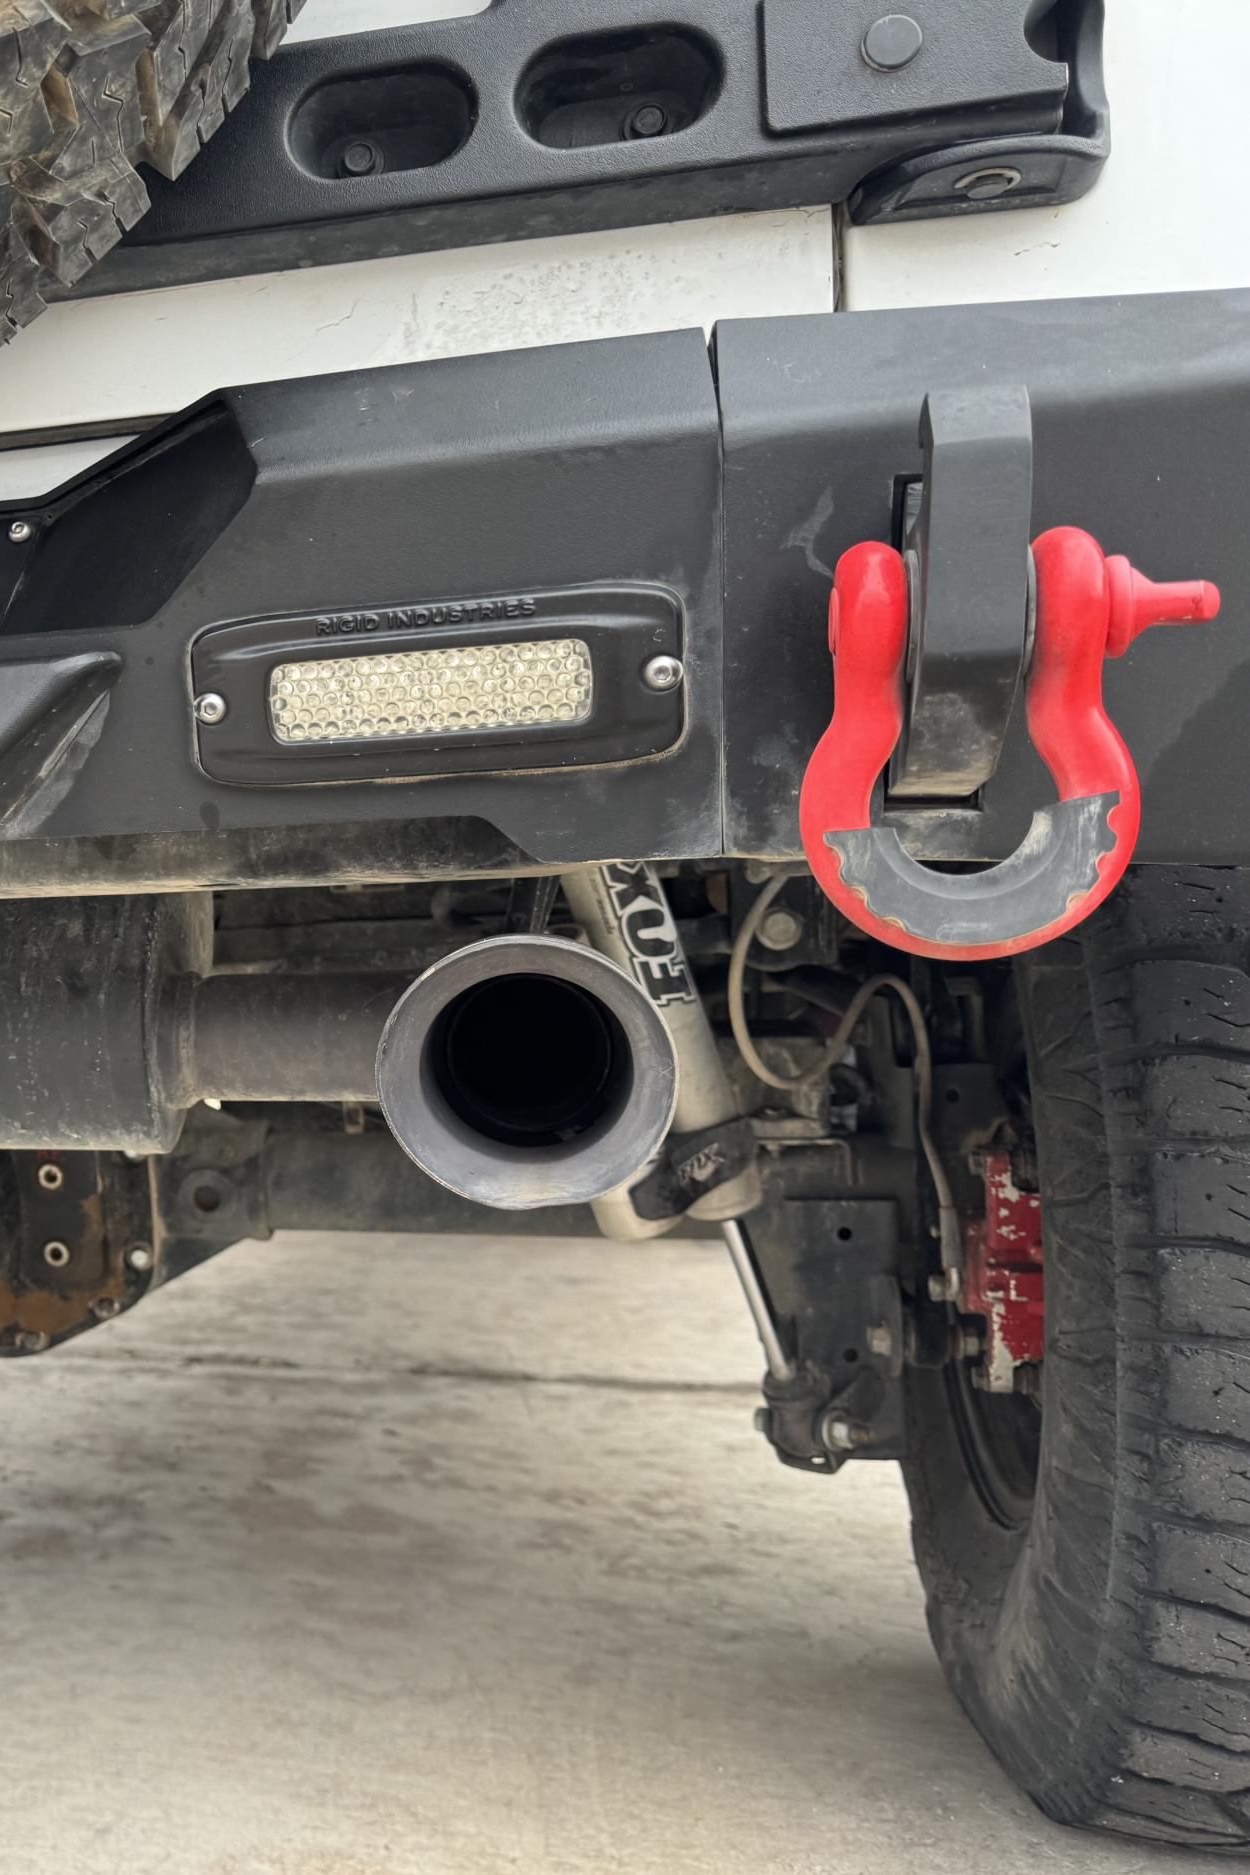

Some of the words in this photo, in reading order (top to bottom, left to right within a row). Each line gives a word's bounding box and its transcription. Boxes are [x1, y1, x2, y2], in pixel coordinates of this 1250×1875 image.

[315, 616, 380, 636] RIGID
[386, 597, 537, 629] INDUSTRIES
[602, 861, 693, 1004] FOX
